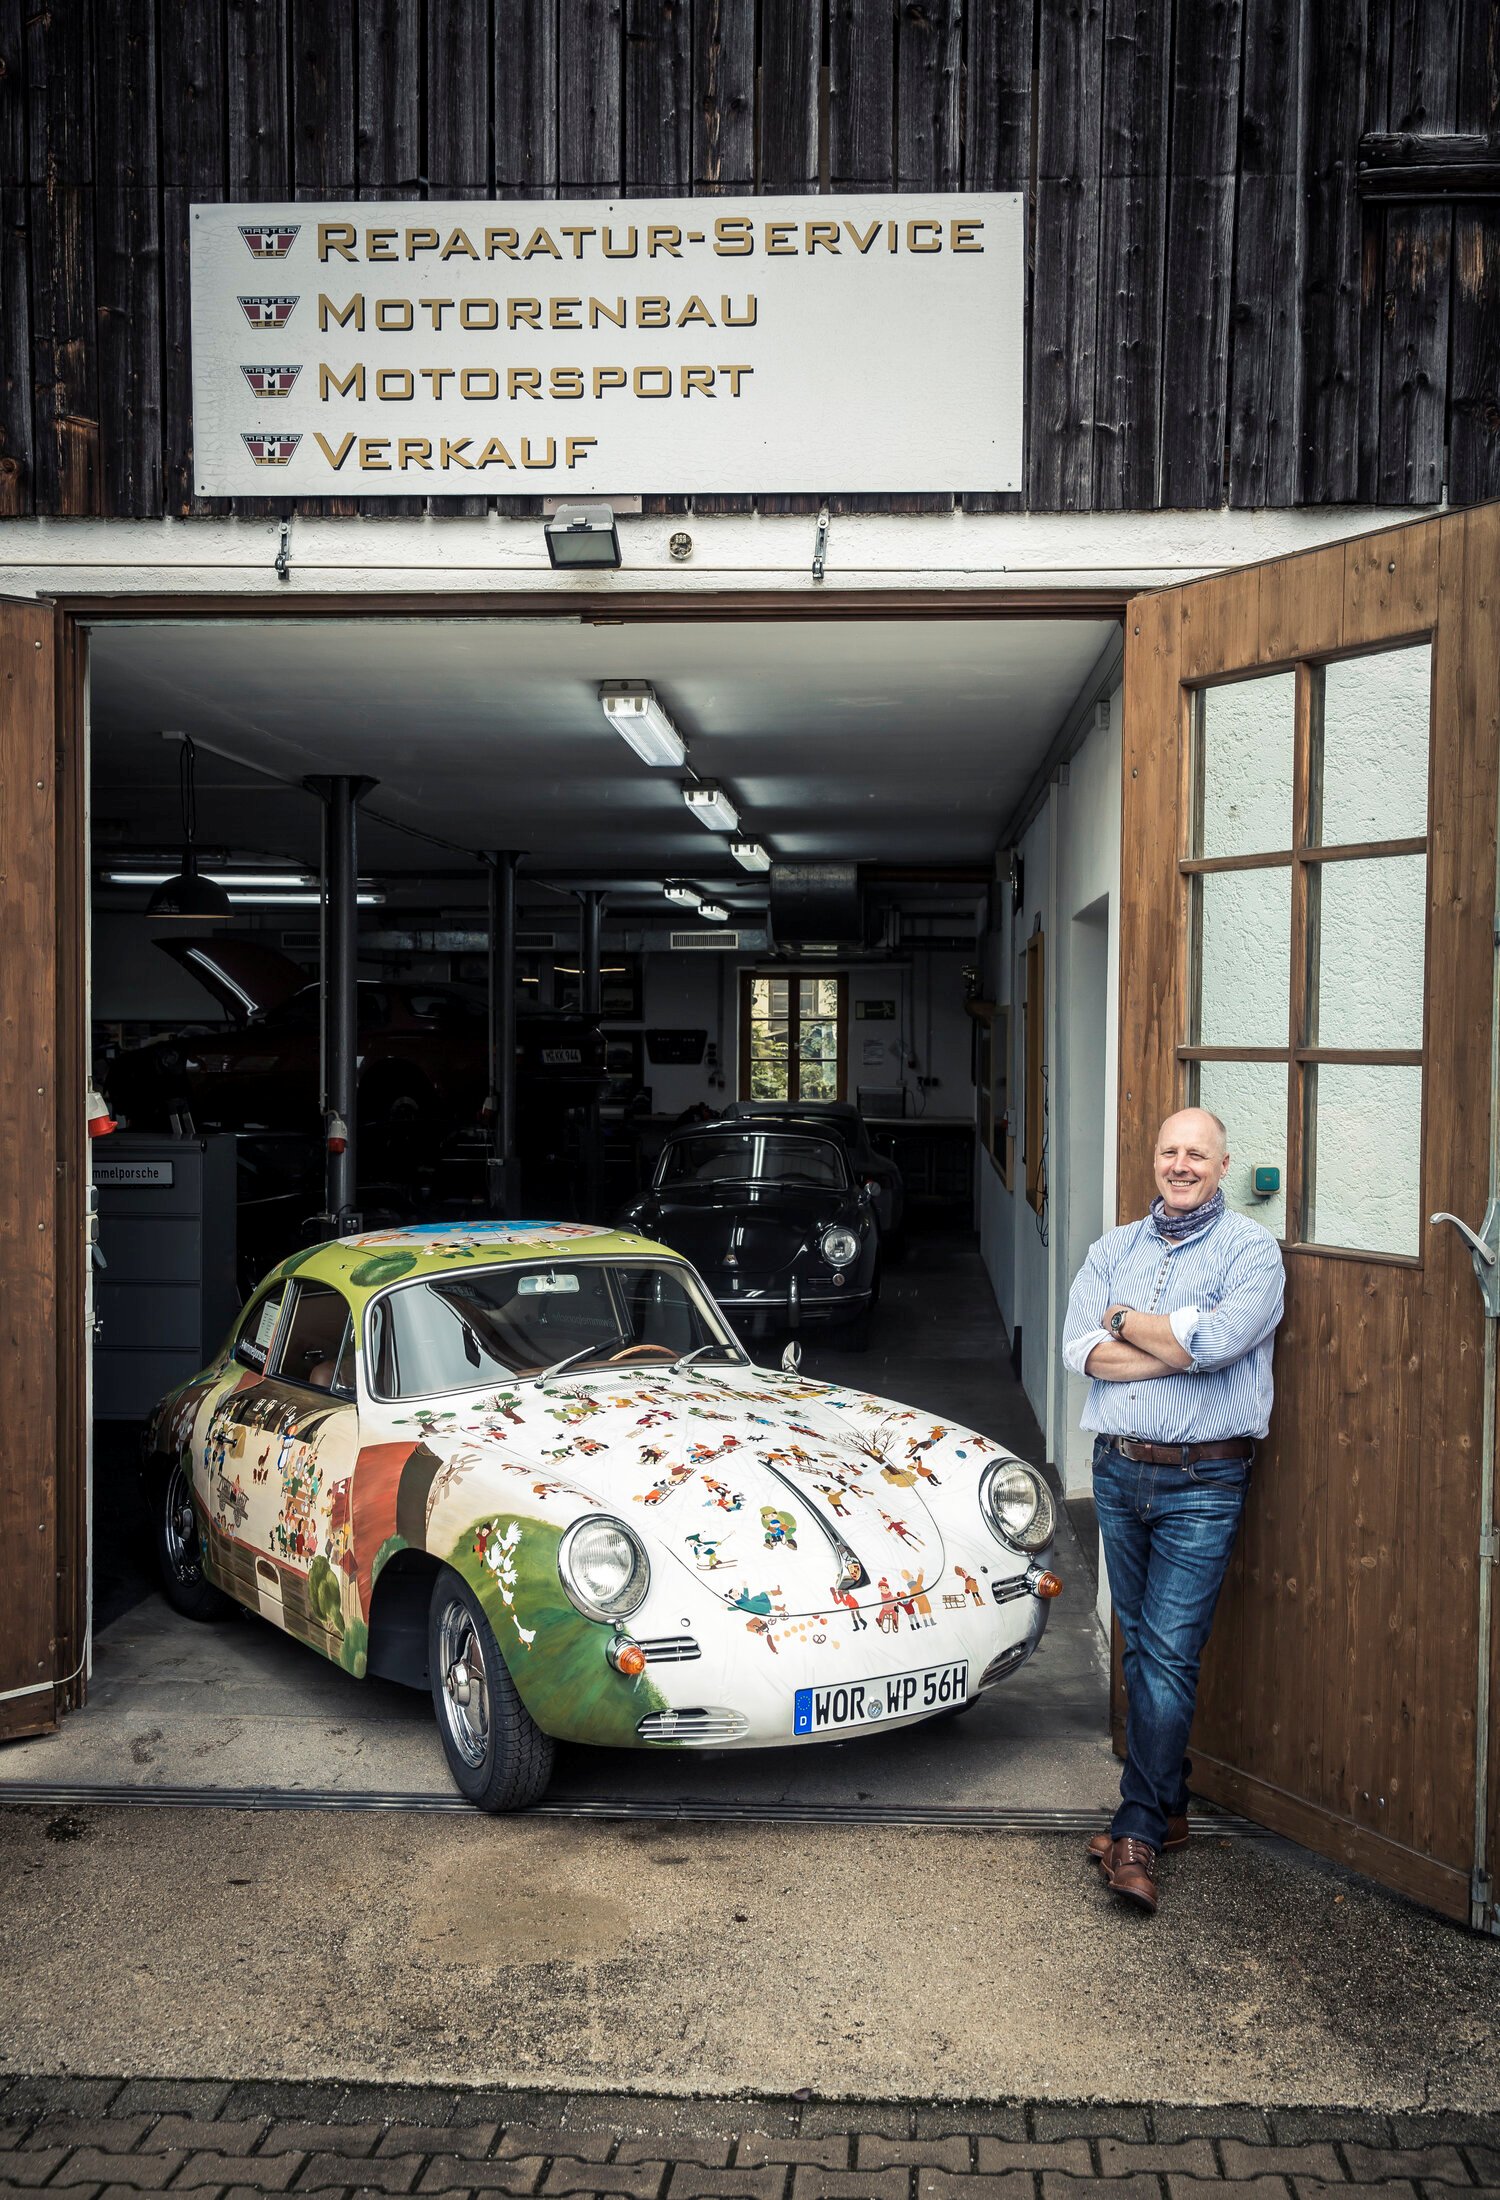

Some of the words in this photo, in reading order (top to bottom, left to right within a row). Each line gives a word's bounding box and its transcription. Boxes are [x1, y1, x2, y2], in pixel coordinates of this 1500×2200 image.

[317, 217, 985, 263] REPARATUR-SERVICE
[318, 293, 758, 332] MOTORENBAU
[318, 363, 754, 401] MOTORSPORT
[313, 432, 598, 471] VERKAUF
[815, 1687, 865, 1725] WOR
[886, 1677, 917, 1713] WP
[924, 1666, 967, 1706] 56H
[799, 1715, 807, 1726] D
